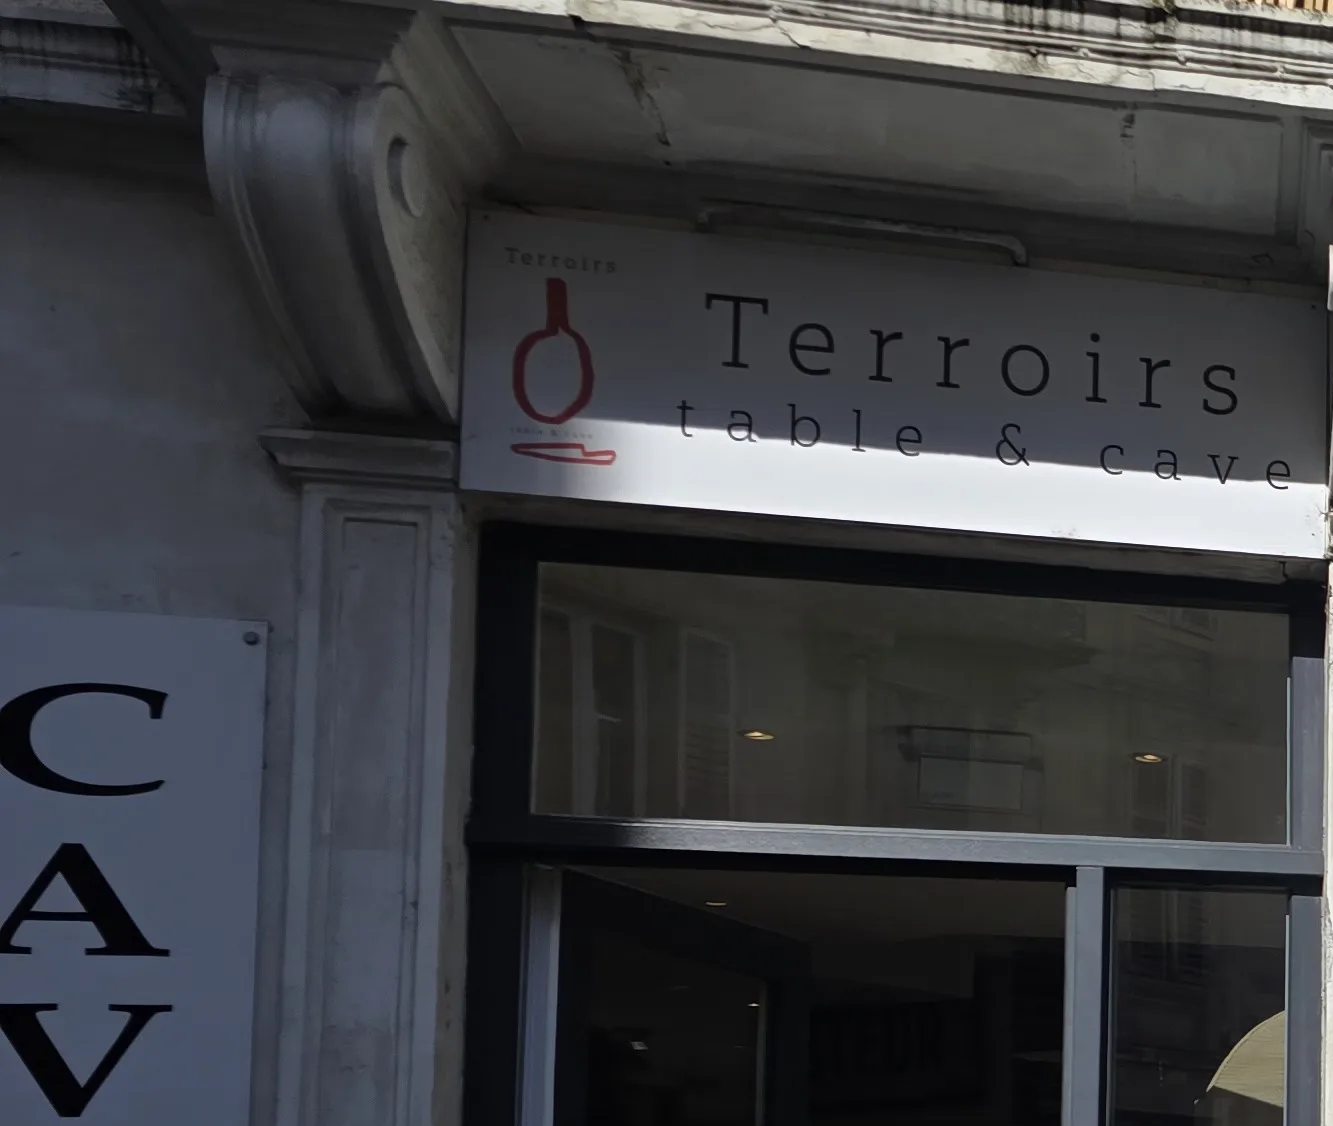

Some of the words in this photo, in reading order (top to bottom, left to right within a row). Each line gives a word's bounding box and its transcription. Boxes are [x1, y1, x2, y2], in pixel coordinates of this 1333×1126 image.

[504, 246, 618, 274] Terroirs
[704, 292, 1243, 417] Terroirs
[676, 401, 925, 457] table
[995, 423, 1032, 468] &
[1098, 438, 1294, 491] cave
